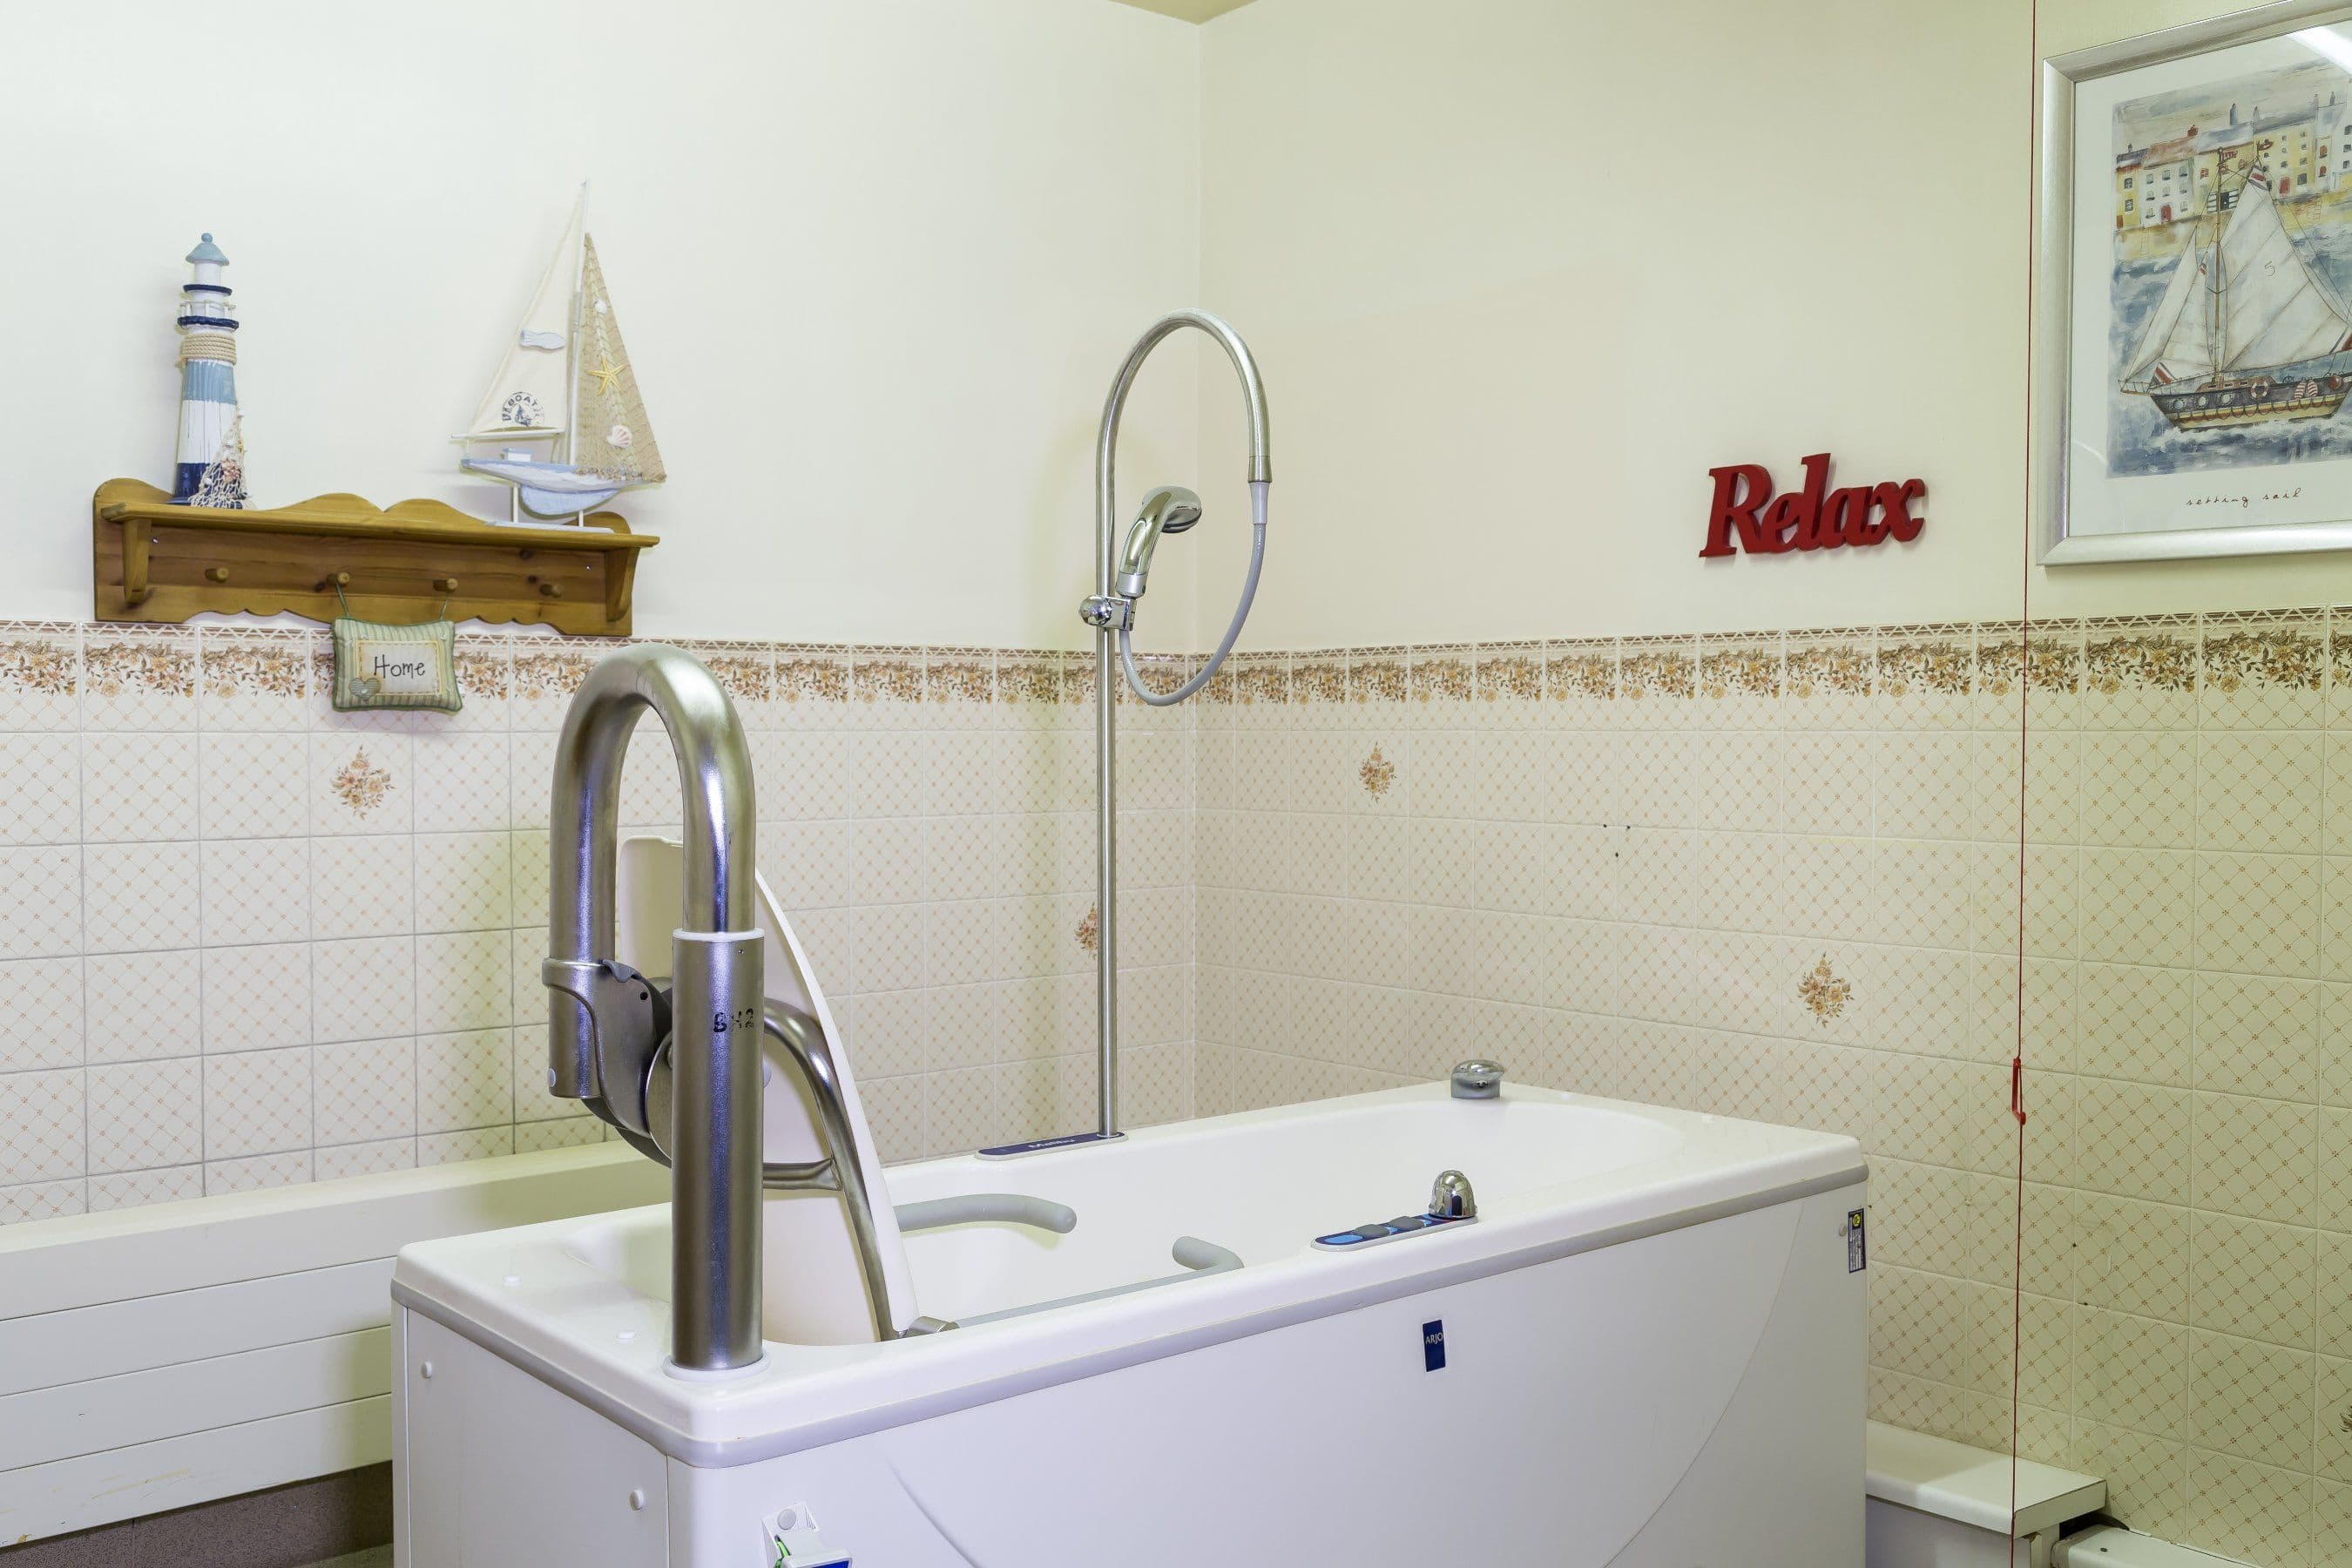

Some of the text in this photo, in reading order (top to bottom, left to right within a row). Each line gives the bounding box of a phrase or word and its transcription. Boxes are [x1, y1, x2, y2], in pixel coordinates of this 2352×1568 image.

[507, 395, 537, 407] BOAT
[1699, 453, 1925, 558] Relax
[2186, 487, 2301, 508] setting sail
[374, 654, 426, 679] Home
[1425, 1332, 1443, 1345] ARJO
